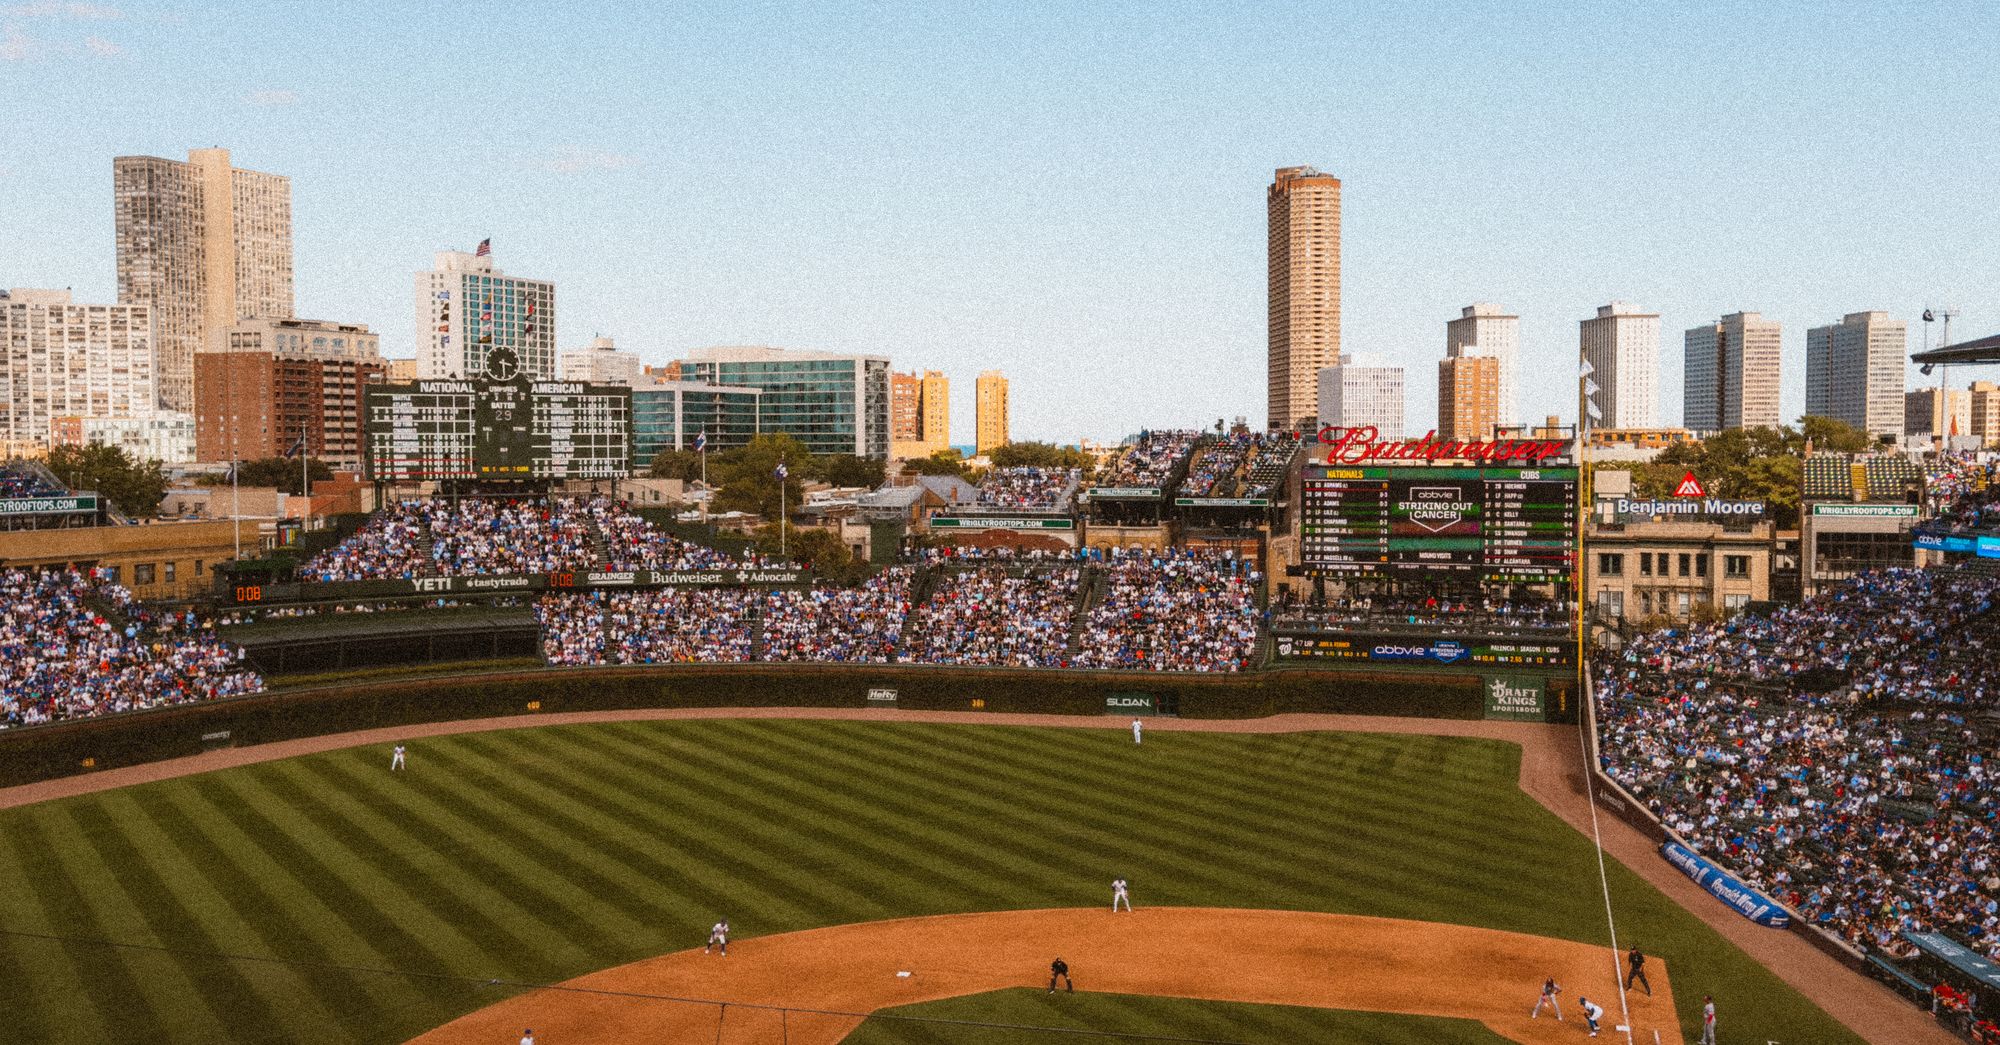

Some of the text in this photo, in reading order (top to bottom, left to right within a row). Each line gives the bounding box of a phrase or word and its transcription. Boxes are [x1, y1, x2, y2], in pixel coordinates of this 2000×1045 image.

[420, 382, 476, 392] NATIONAL
[531, 384, 583, 393] AMERICAN
[496, 410, 511, 420] 29
[1318, 426, 1564, 464] Budweiser
[1327, 470, 1364, 478] NATIONALS
[1520, 471, 1540, 479] CUBS
[1398, 502, 1449, 510] STRIKING
[1618, 500, 1763, 516] Benjamin Moore
[651, 572, 721, 583] Budweiser
[750, 572, 797, 582] Advocate
[412, 578, 451, 591] YETI
[475, 577, 528, 588] tastytrade
[1375, 645, 1424, 656] abbvie
[870, 690, 895, 700] Hefty
[1493, 688, 1538, 698] DRAFT
[1107, 698, 1149, 707] SLOAN
[1499, 696, 1536, 705] KINGS
